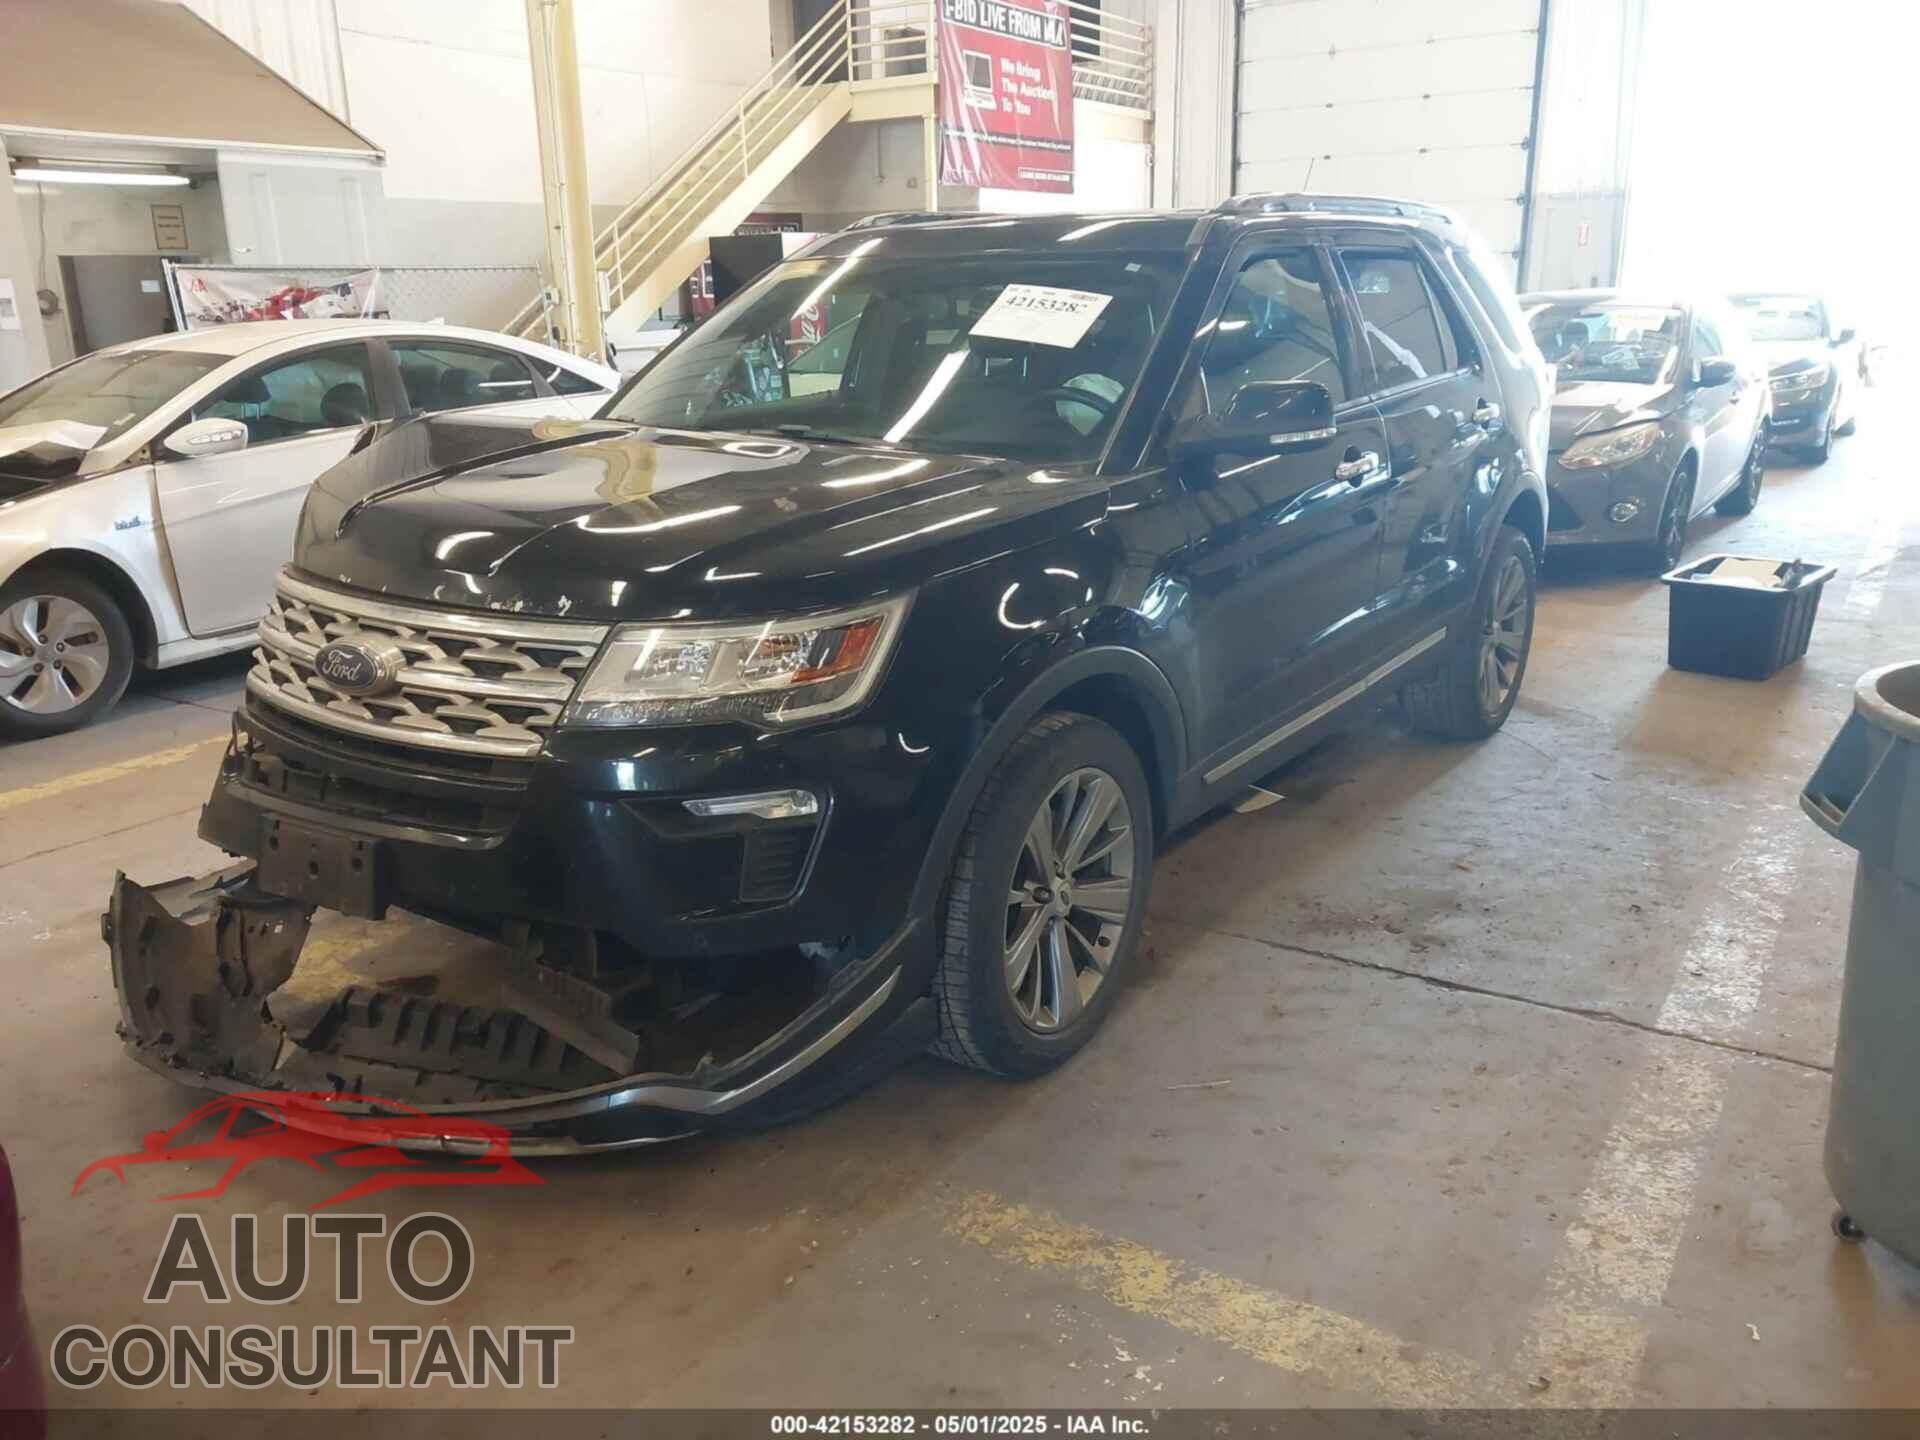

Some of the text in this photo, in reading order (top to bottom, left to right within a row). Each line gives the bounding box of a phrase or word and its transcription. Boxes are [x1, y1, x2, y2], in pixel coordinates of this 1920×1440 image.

[980, 2, 1007, 32] LIVE
[1008, 9, 1042, 40] FROM
[1000, 57, 1040, 82] We Bring
[1000, 77, 1057, 101] The Auction
[1002, 98, 1031, 115] To You
[322, 648, 362, 682] Ford
